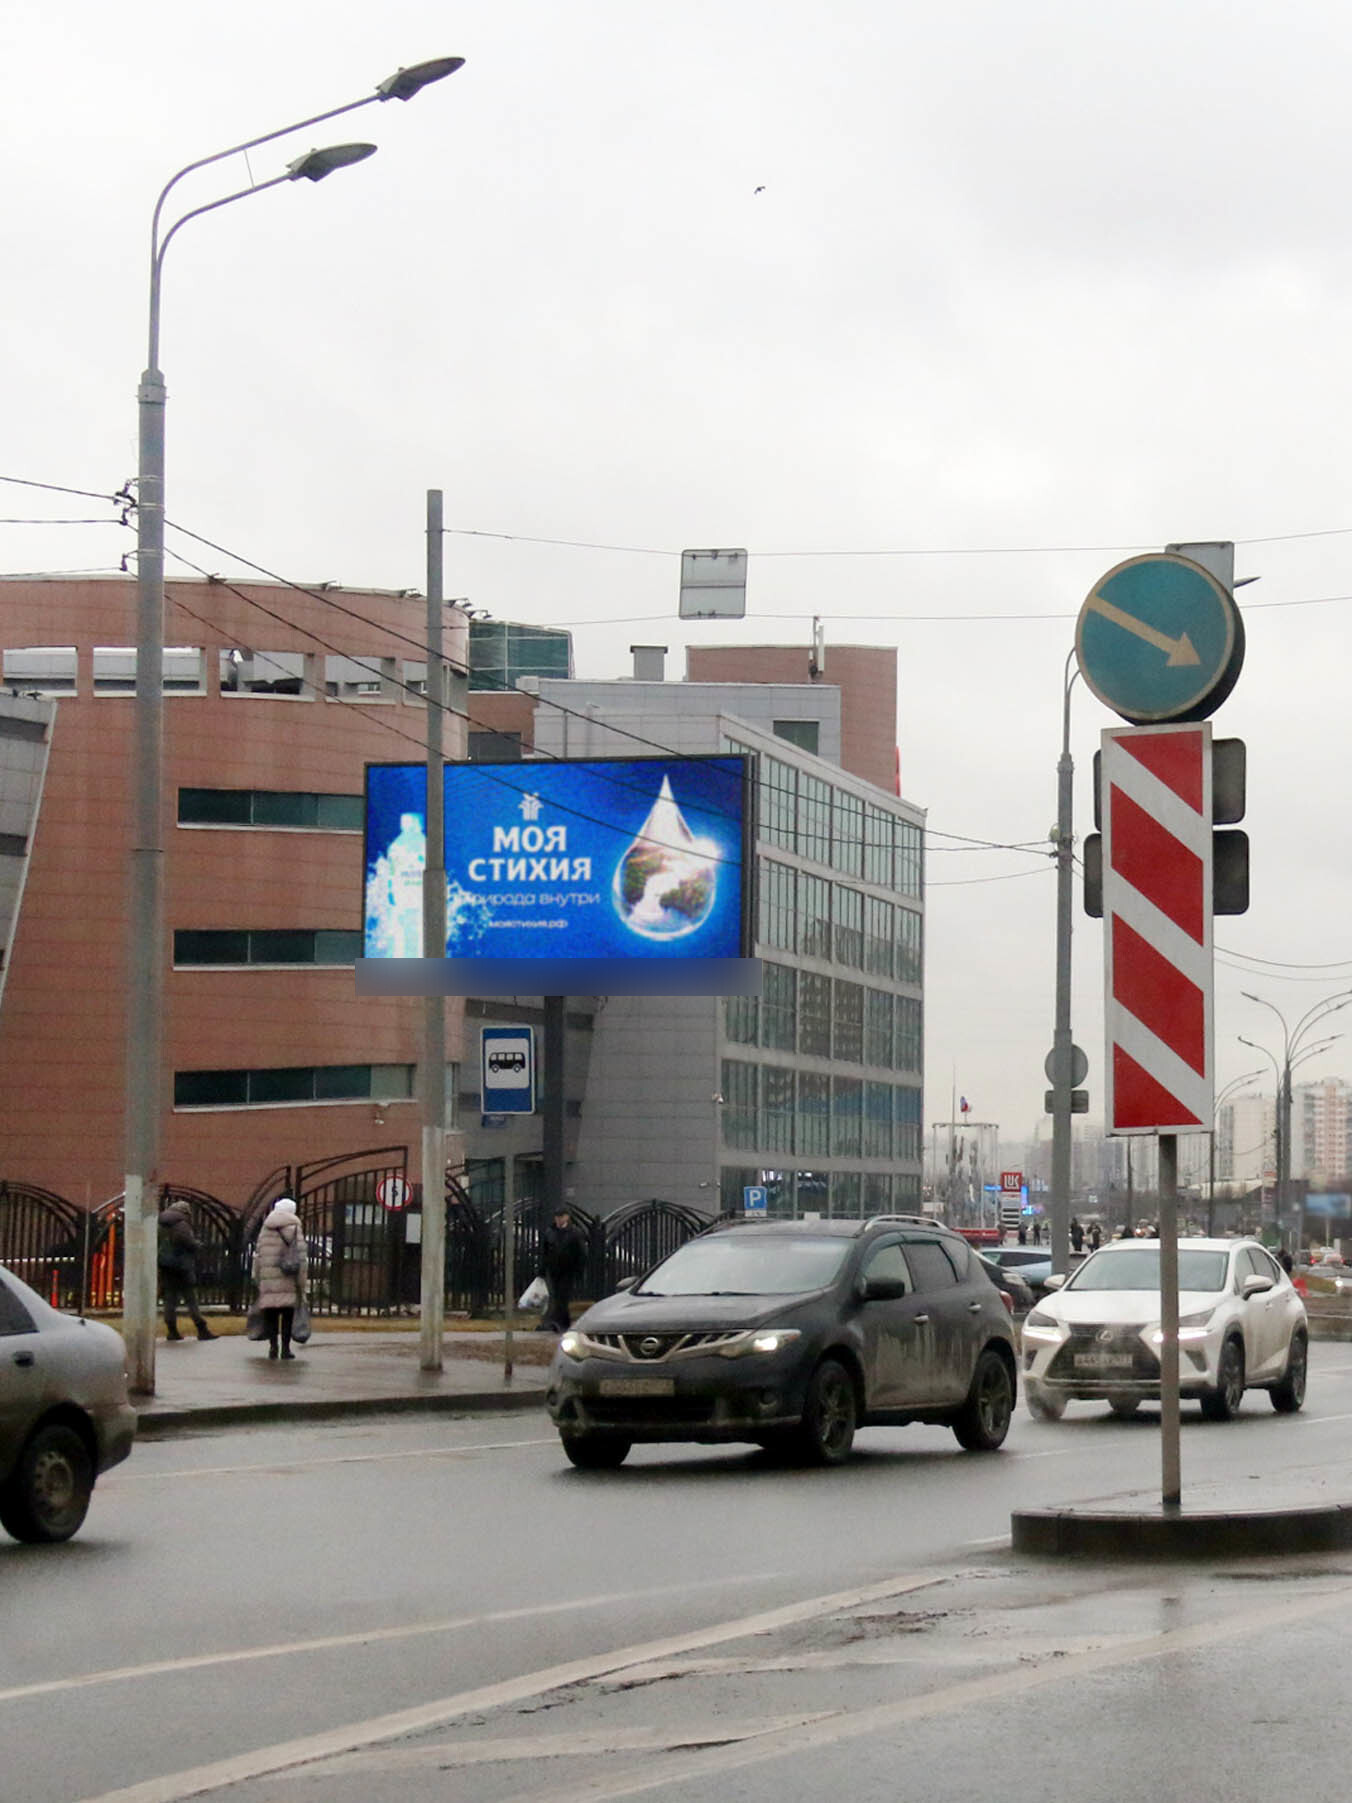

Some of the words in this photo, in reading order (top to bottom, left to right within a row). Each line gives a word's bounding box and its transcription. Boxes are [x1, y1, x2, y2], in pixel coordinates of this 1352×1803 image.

[492, 825, 568, 852] МОЯ
[467, 857, 592, 883] СТИХИЯ
[539, 892, 600, 907] внутри
[749, 1190, 761, 1207] P
